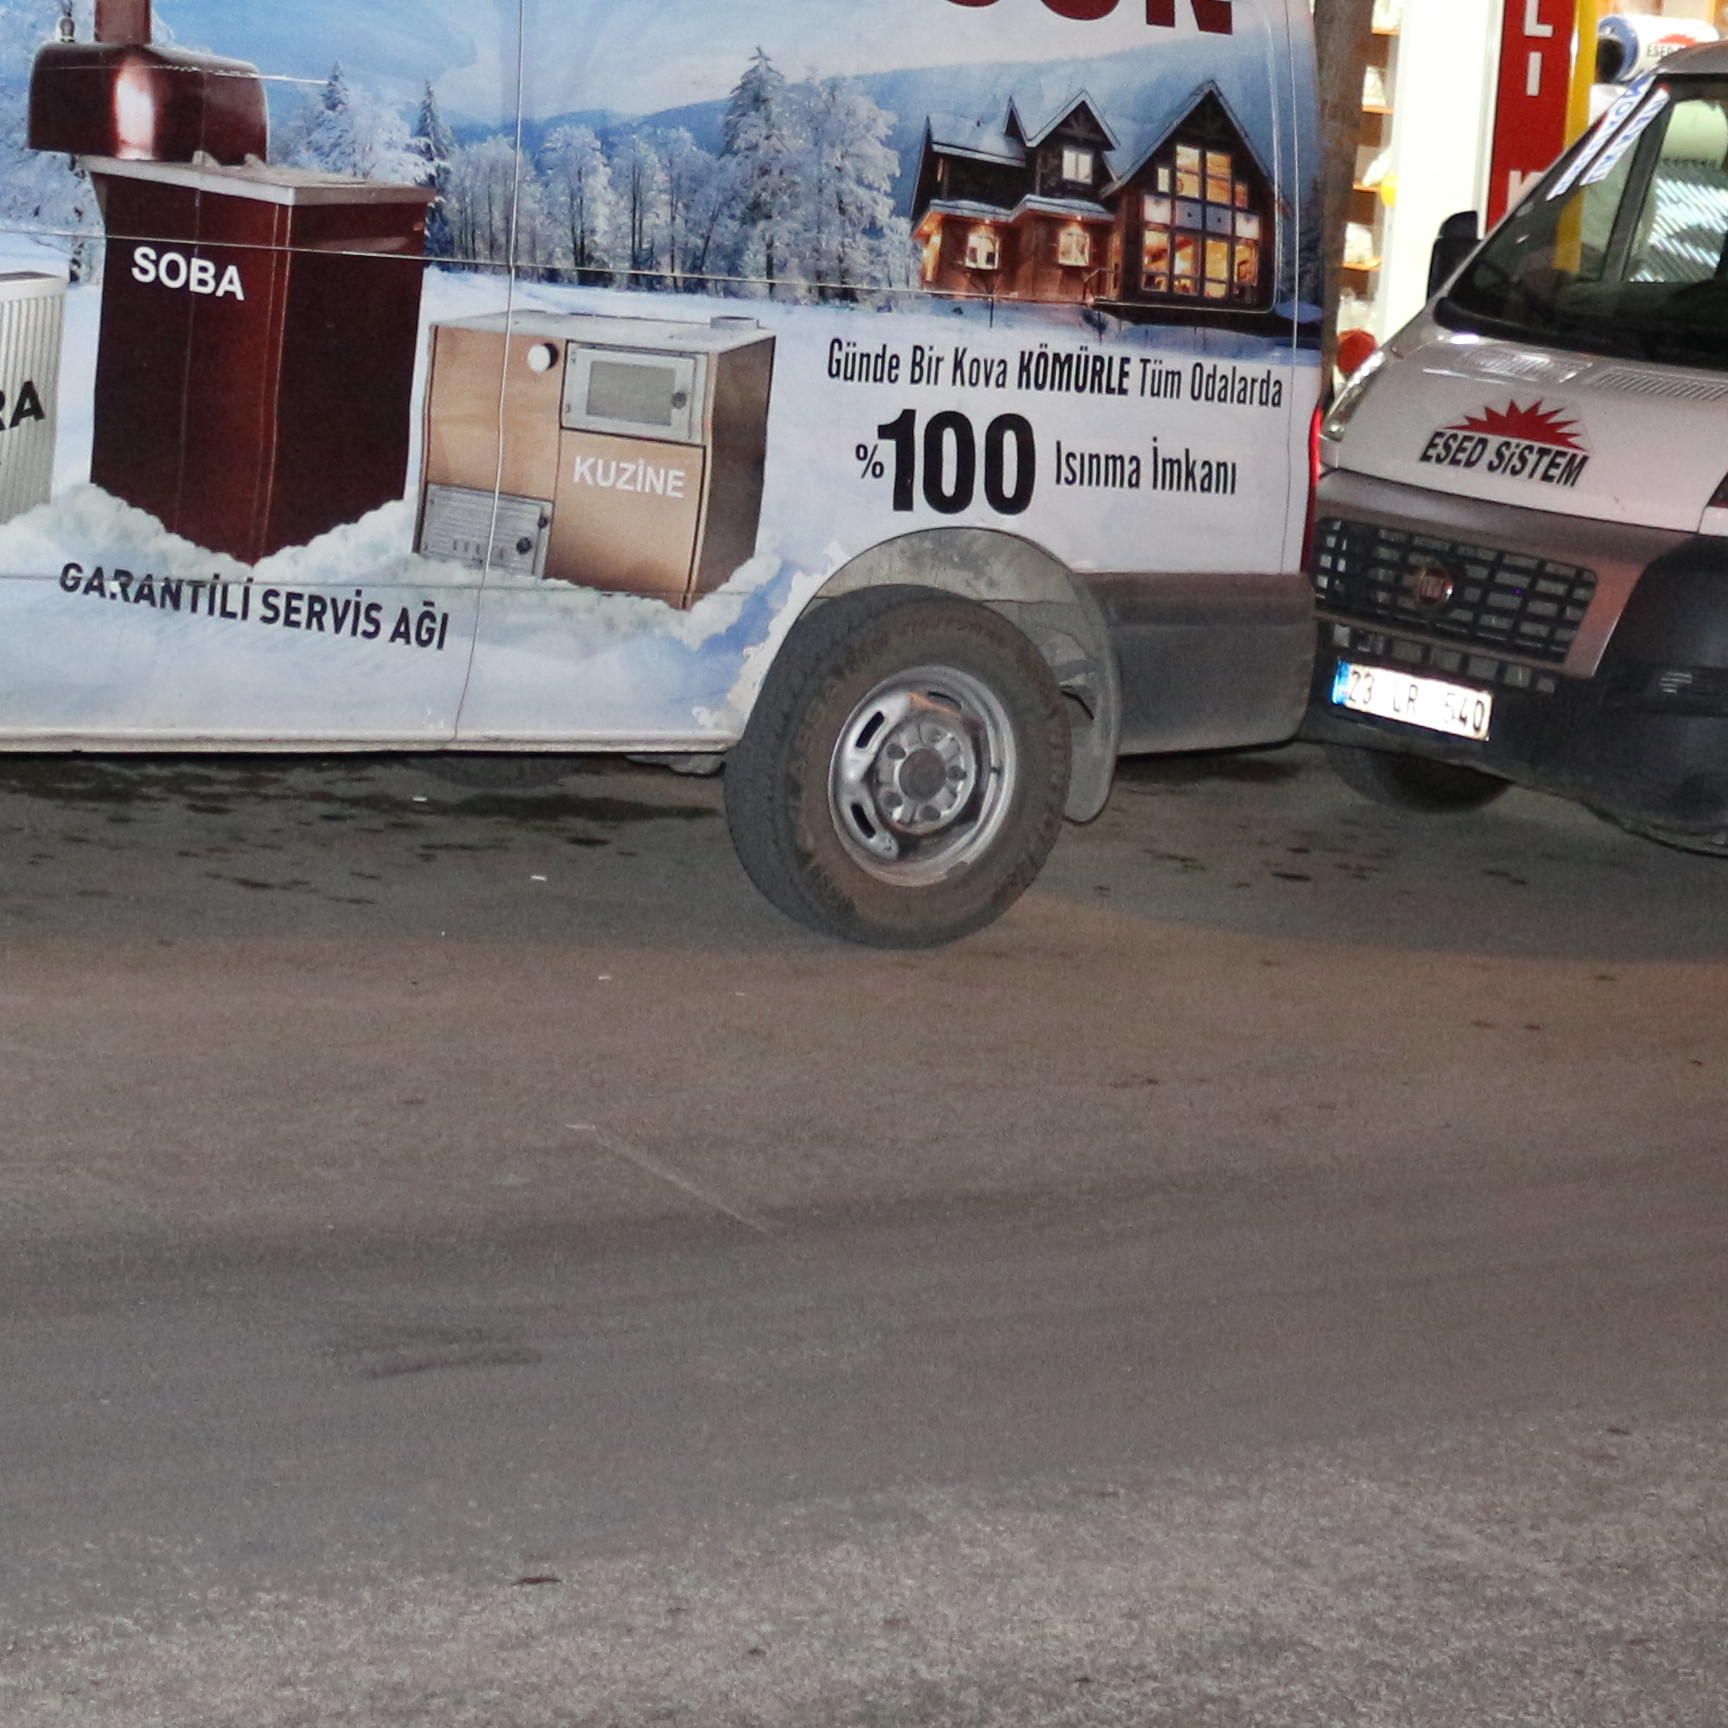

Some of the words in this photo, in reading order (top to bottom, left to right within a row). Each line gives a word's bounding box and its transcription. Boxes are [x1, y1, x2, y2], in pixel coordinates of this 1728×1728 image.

[130, 245, 246, 301] SOBA
[826, 336, 902, 388] Günde
[908, 344, 946, 387] Bir
[951, 347, 1010, 392] Kova
[1017, 345, 1131, 398] KÖMÜRLE
[1138, 356, 1183, 402] Tüm
[1188, 360, 1284, 409] Odalarda
[572, 450, 688, 501] KUZİNE
[1054, 440, 1143, 494] Isınma
[1149, 434, 1238, 498] İmkanı
[1418, 429, 1487, 467] ESED
[58, 561, 251, 623] GARANTİLİ
[260, 588, 383, 642] SERVİS
[389, 601, 450, 651] AĞI
[1347, 670, 1375, 705] 23
